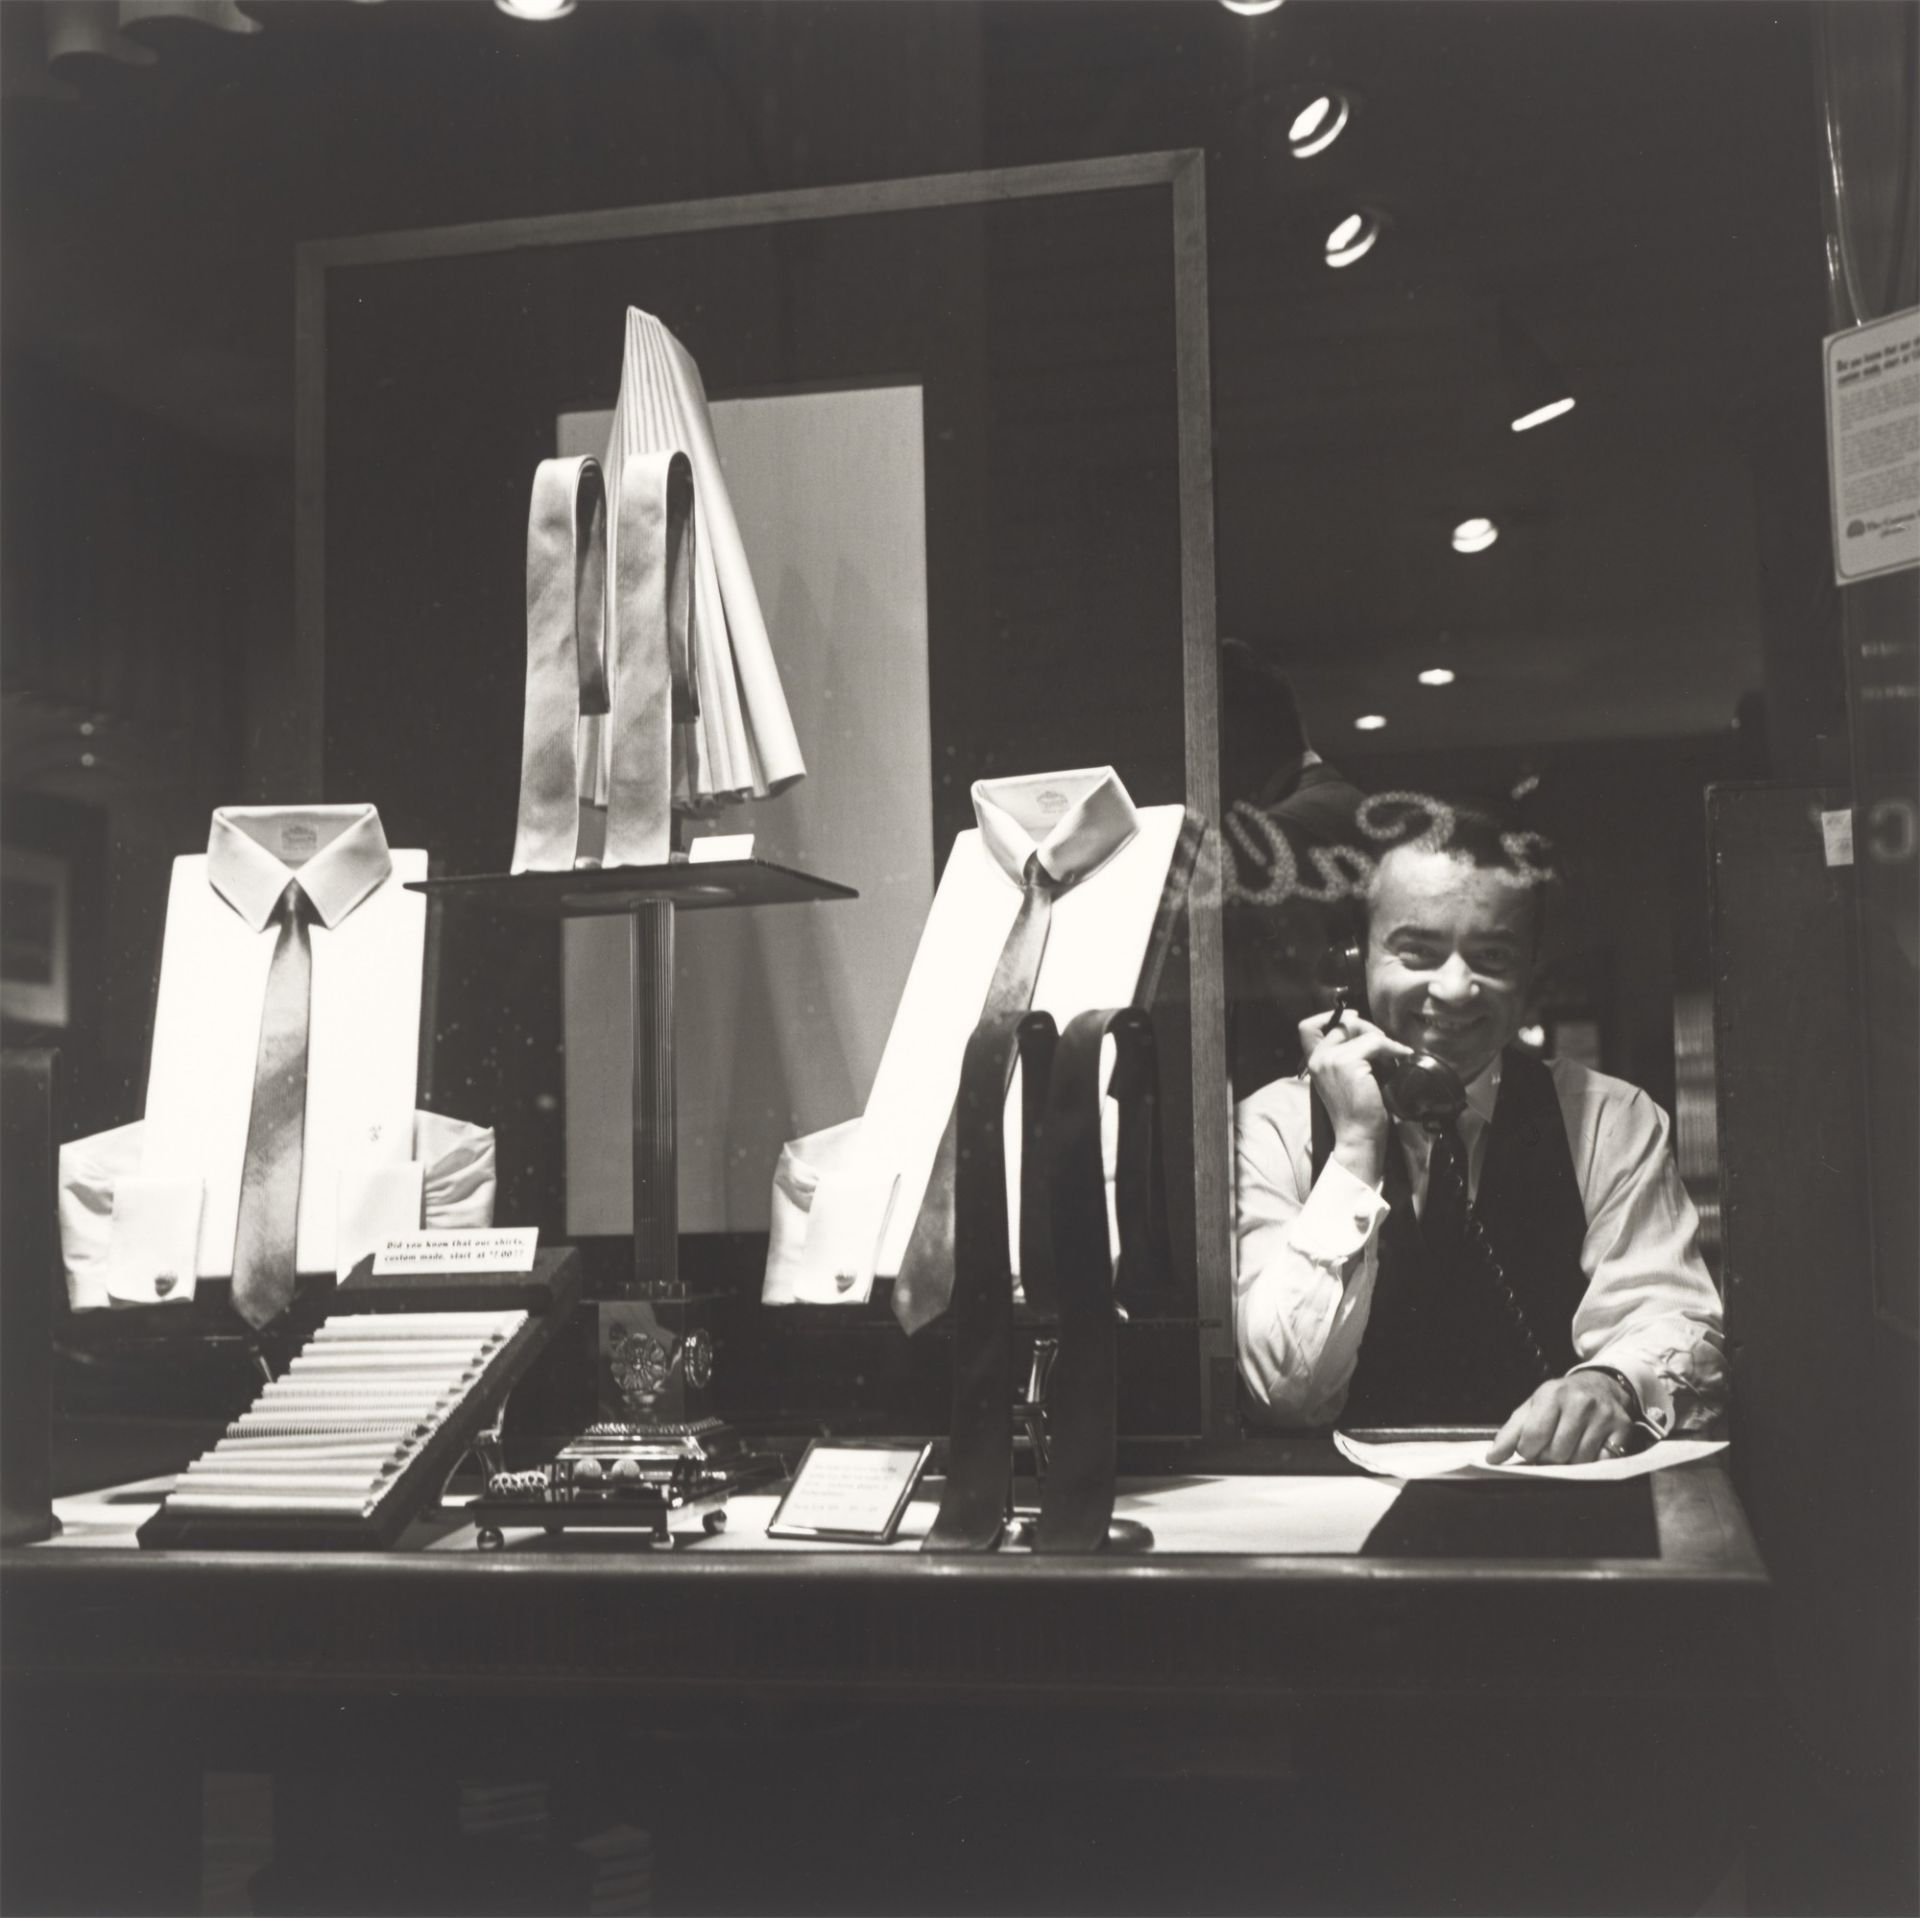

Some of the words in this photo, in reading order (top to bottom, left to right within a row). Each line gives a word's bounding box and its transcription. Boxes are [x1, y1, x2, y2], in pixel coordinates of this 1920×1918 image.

[386, 1241, 403, 1249] Did
[406, 1241, 422, 1250] you
[425, 1239, 449, 1248] know
[451, 1239, 472, 1248] that
[474, 1239, 490, 1248] our
[384, 1254, 416, 1262] custom
[449, 1250, 472, 1260] start
[476, 1250, 486, 1259] at
